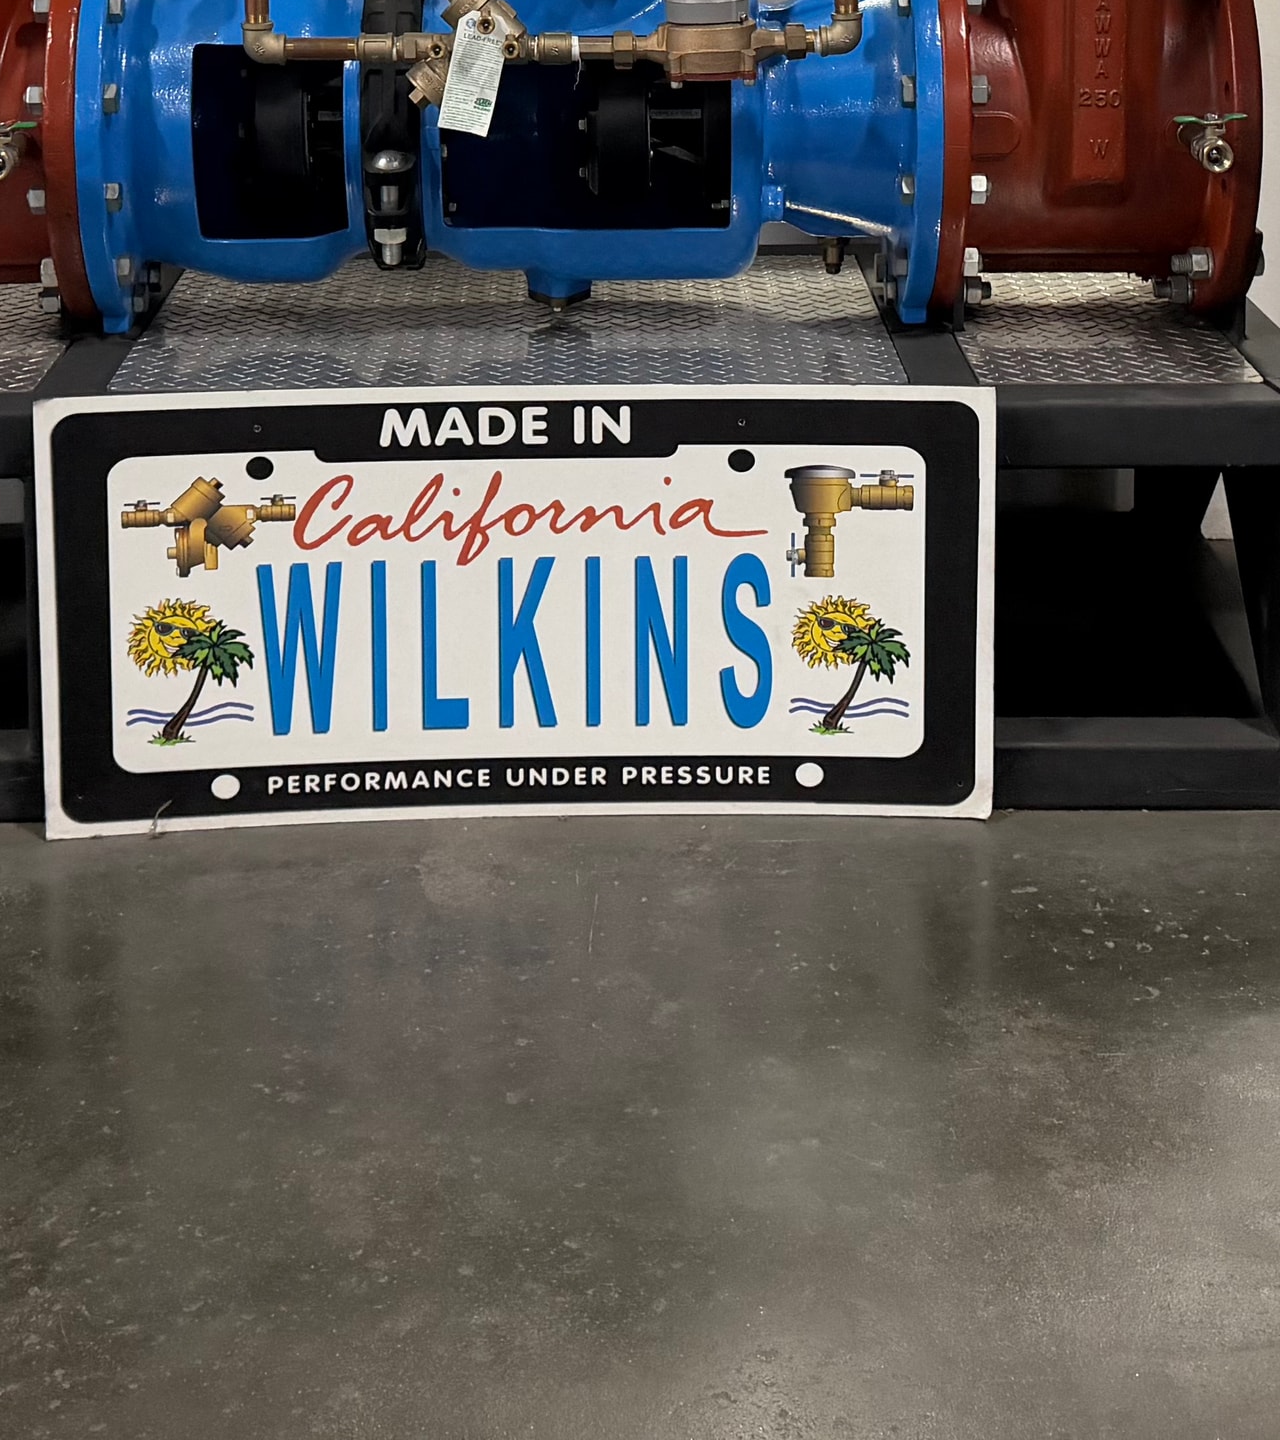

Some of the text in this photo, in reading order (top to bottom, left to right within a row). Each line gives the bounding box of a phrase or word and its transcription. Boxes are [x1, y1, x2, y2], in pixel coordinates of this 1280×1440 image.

[1078, 88, 1122, 107] 250
[379, 405, 631, 447] MADE IN
[293, 470, 768, 566] California
[256, 553, 773, 735] WILKINS
[267, 765, 771, 795] PERFORMANCE UNDER PRESSURE
